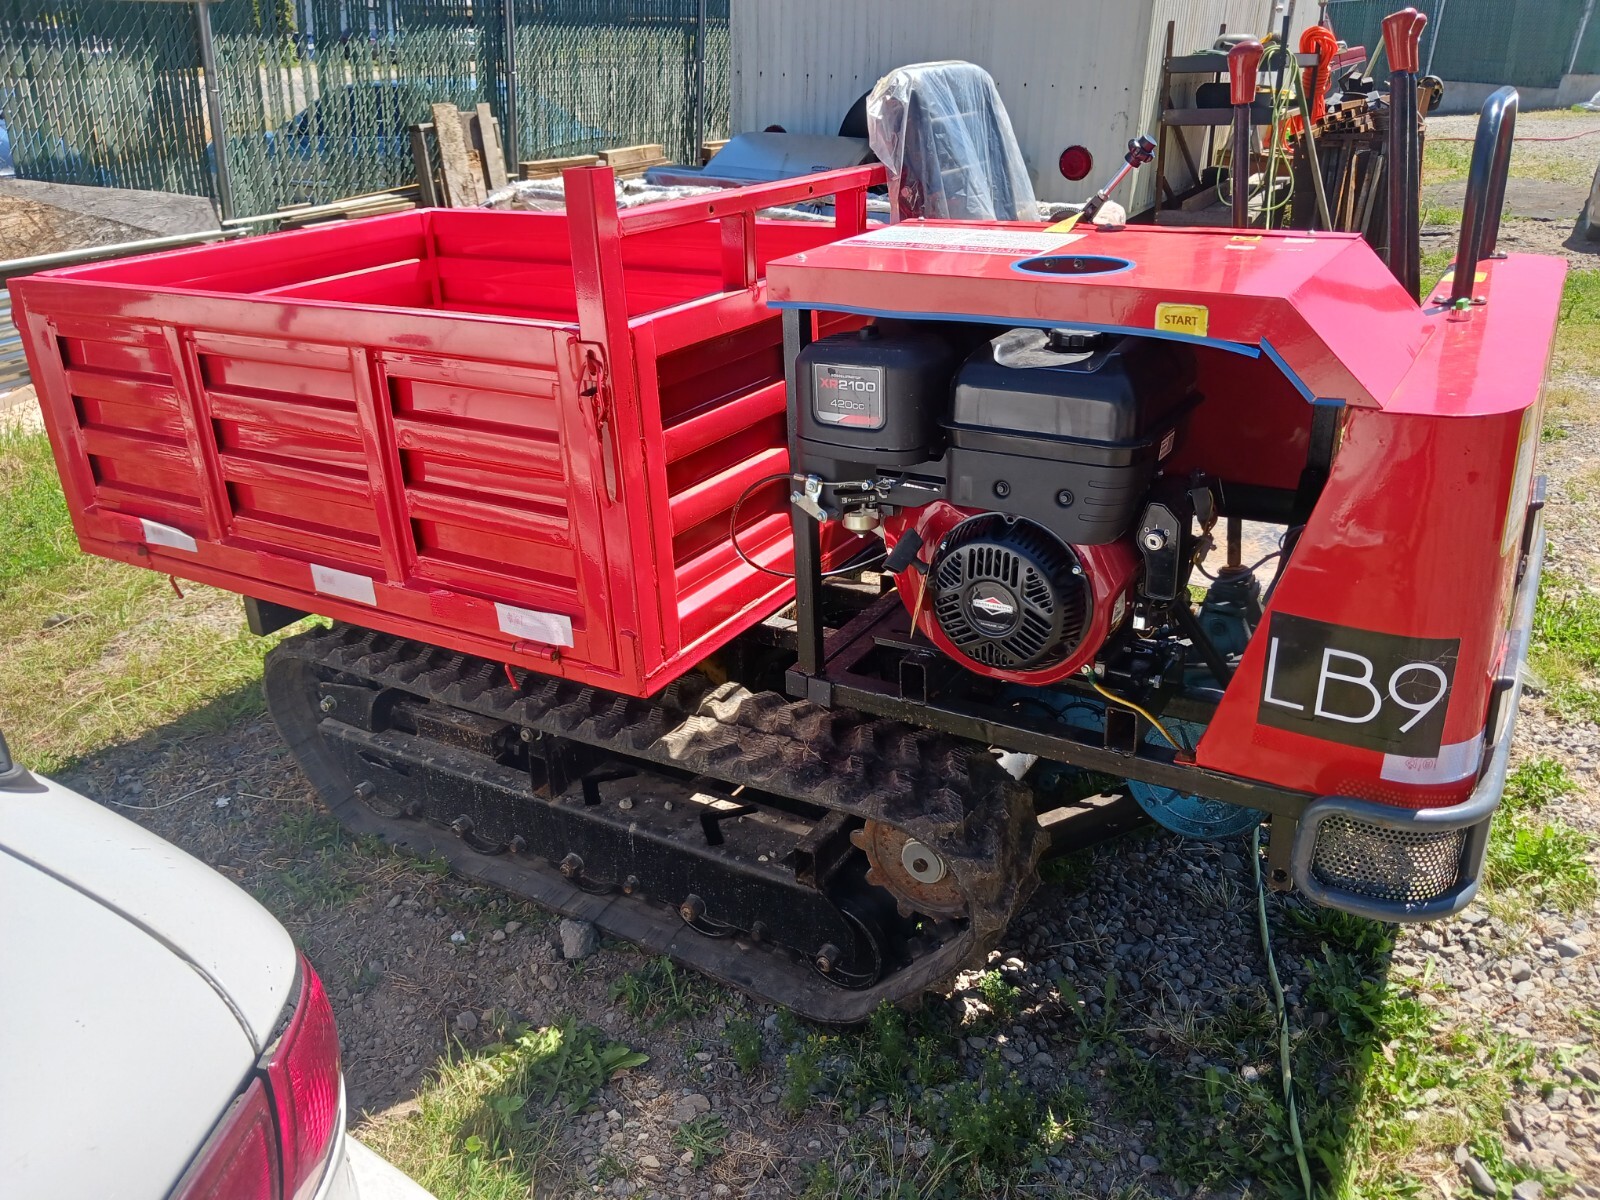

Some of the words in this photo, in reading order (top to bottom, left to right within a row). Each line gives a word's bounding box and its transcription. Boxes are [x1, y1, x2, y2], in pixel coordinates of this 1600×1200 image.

[1164, 314, 1198, 326] START
[820, 377, 876, 392] XR2100
[830, 399, 865, 410] 420cc
[1264, 637, 1448, 734] LB9
